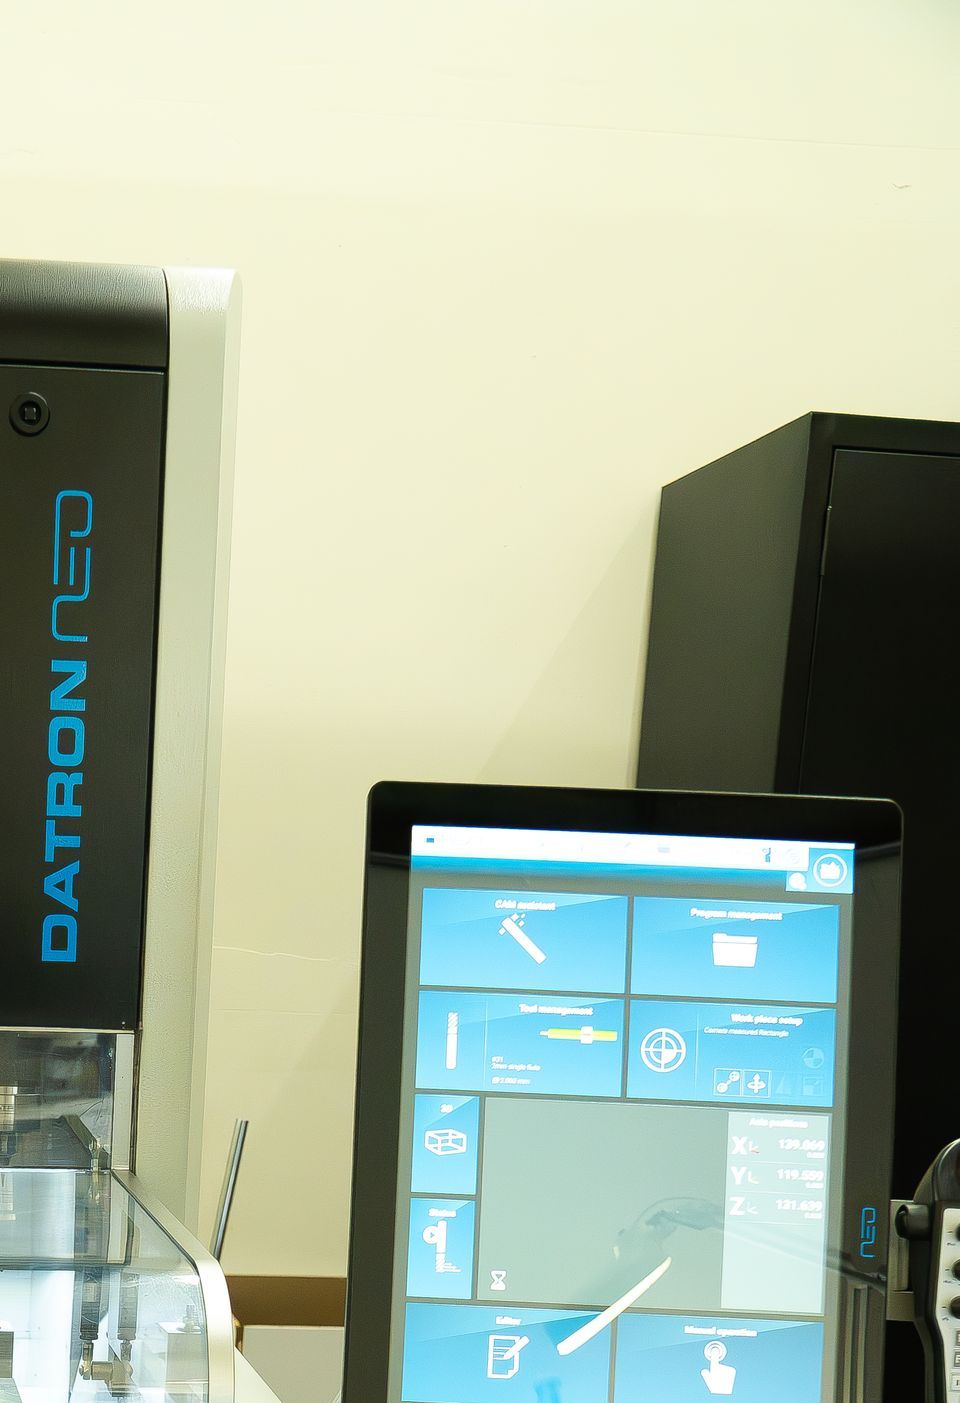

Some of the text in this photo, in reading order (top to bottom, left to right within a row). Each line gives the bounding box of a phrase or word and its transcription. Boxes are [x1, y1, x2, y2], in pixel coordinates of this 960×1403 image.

[41, 659, 89, 962] DATRON
[689, 908, 783, 921] Program management
[519, 1003, 594, 1016] Tool management
[732, 1136, 748, 1155] X
[731, 1166, 747, 1185] Y
[729, 1197, 745, 1215] Z
